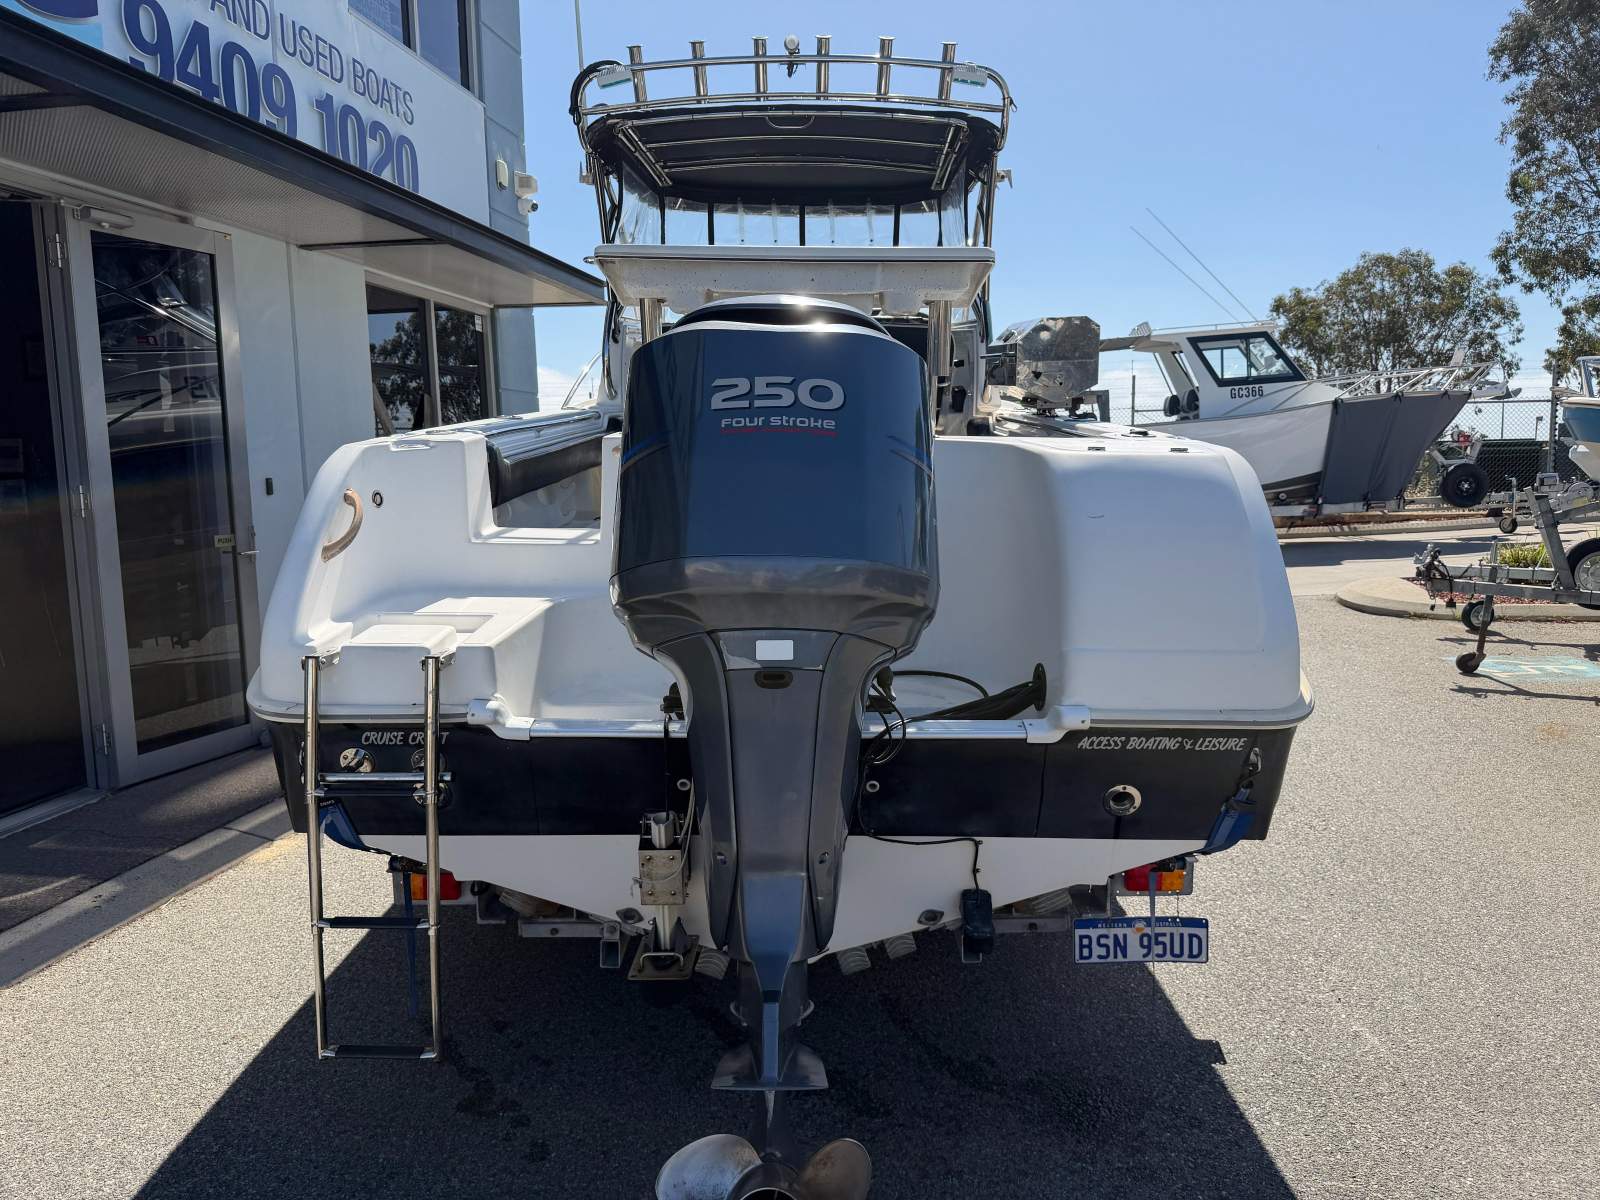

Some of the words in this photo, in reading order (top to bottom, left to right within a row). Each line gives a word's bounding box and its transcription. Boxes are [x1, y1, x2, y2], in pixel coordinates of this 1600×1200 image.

[280, 13, 344, 84] USED
[352, 57, 415, 126] BOATS
[122, 0, 298, 140] 9409
[314, 93, 419, 193] 1020
[711, 376, 845, 410] 250
[1230, 386, 1264, 399] GC366
[361, 731, 405, 745] CRUISE
[408, 731, 449, 745] CRT
[1077, 736, 1126, 750] ACCESS
[1126, 736, 1182, 750] BOATING
[1195, 737, 1248, 751] LEISURE
[1079, 933, 1128, 960] BSN
[1139, 932, 1203, 959] 95UD
